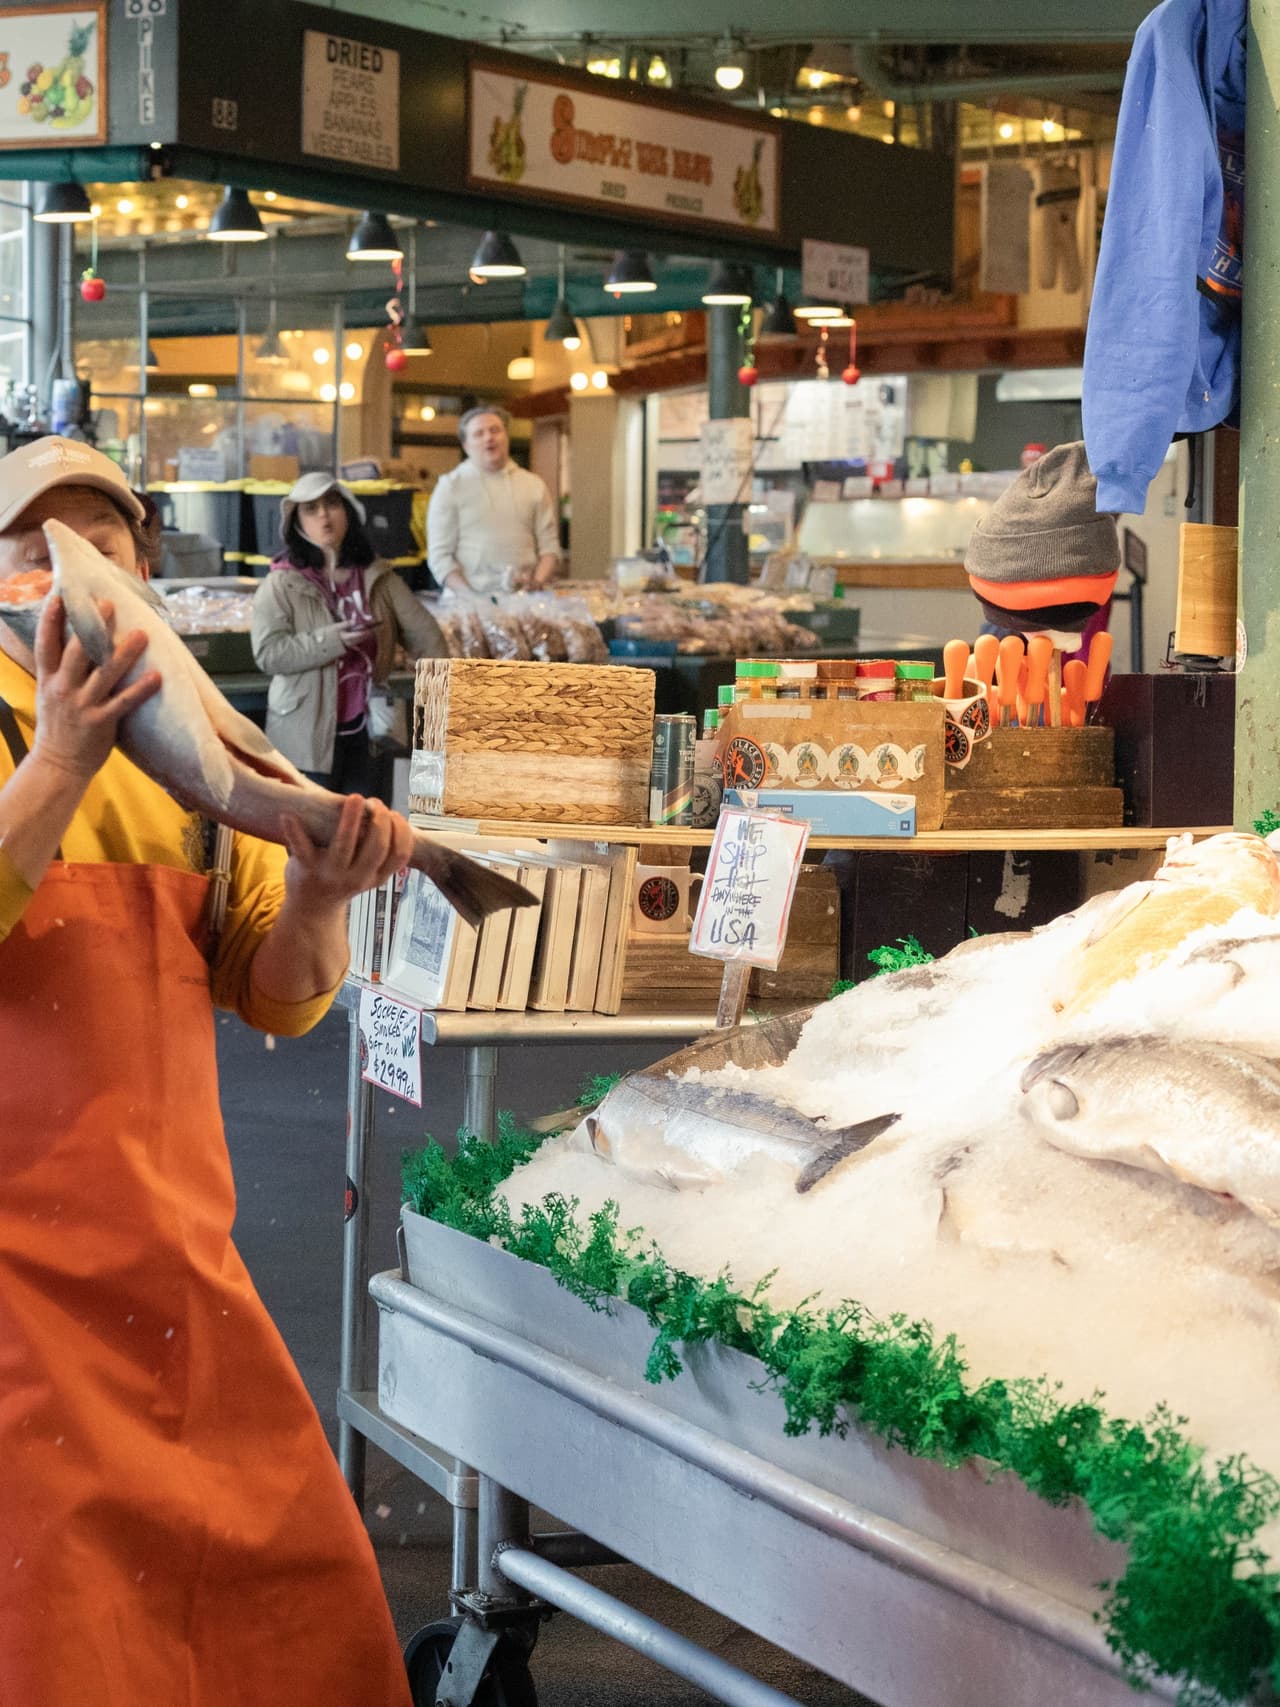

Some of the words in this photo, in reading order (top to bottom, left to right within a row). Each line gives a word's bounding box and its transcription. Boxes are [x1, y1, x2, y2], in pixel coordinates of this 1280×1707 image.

[327, 39, 383, 73] DRIED
[737, 816, 767, 845] WE
[720, 841, 768, 871] SHIP
[711, 886, 762, 908] ANYWHERE
[710, 914, 759, 950] USA
[371, 996, 408, 1026] SOCKEYE
[374, 1020, 401, 1038] SMOKED
